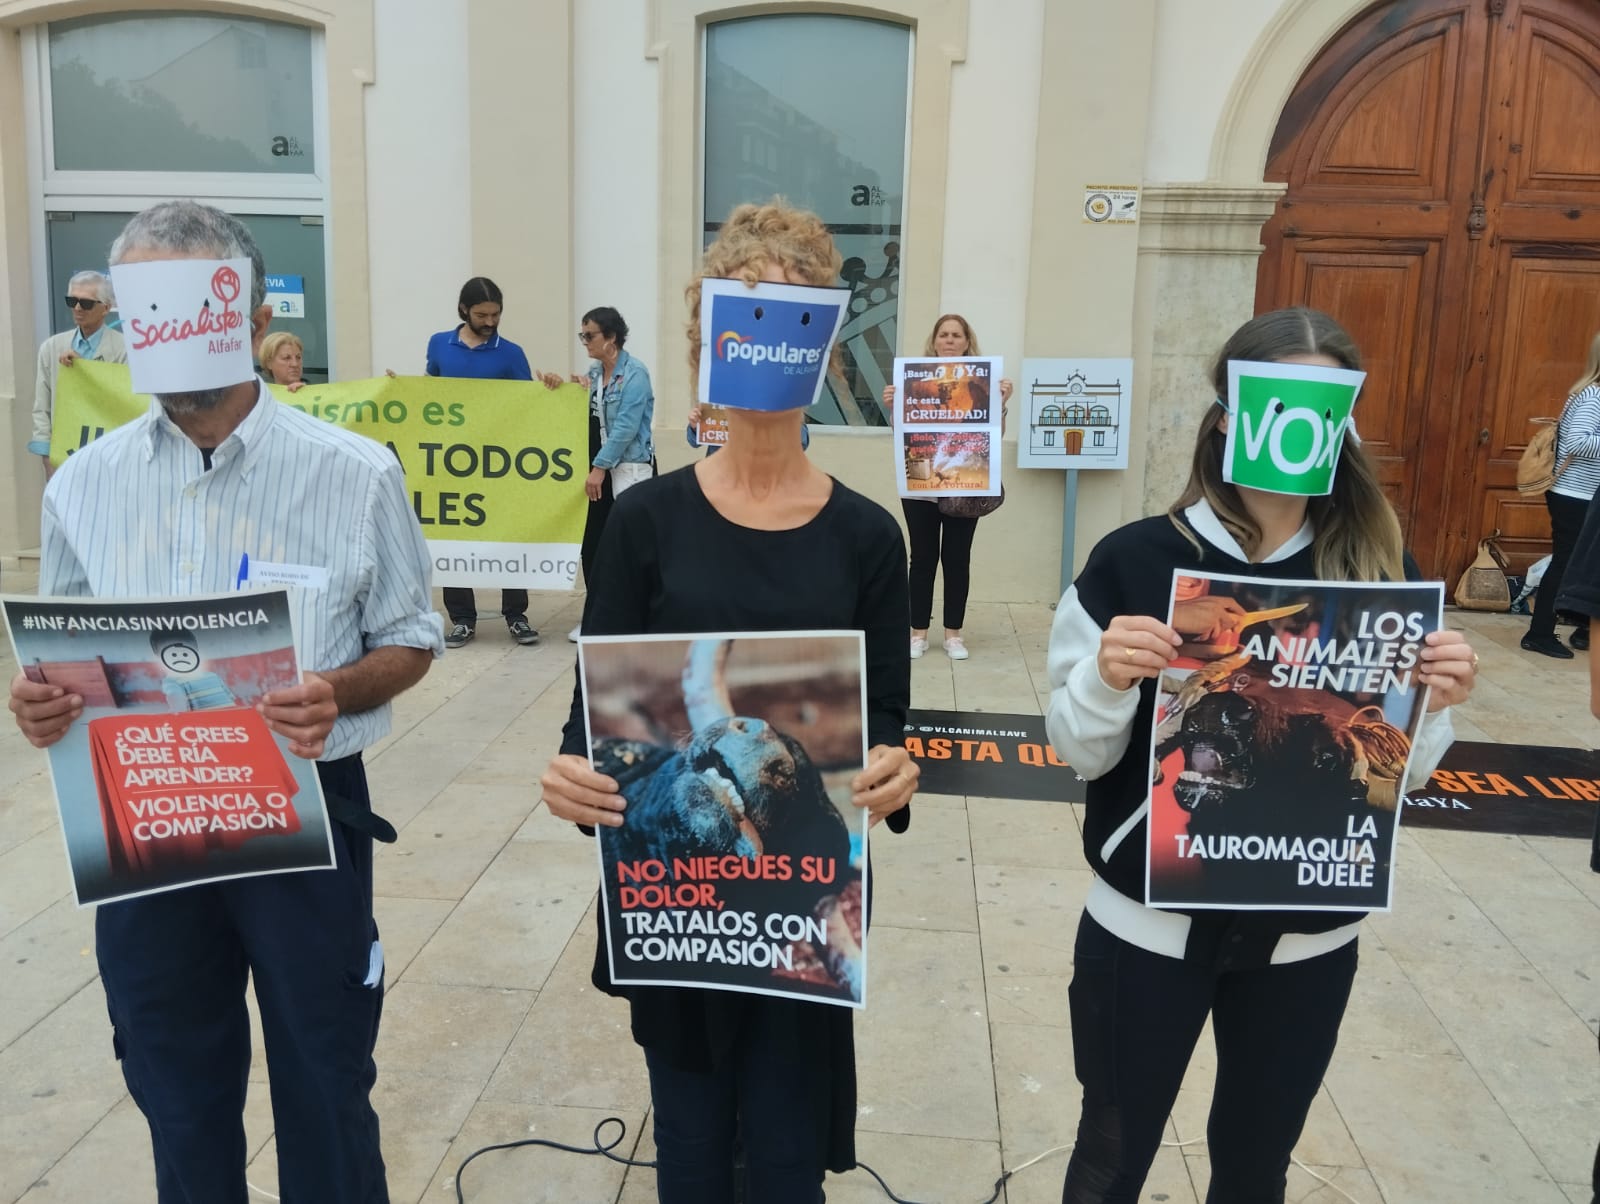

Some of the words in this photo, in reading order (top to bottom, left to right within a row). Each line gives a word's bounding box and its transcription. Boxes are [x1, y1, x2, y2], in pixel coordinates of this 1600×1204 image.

[208, 338, 242, 354] Alfafar
[727, 342, 821, 365] populares
[784, 366, 794, 375] DE
[423, 401, 465, 426] es
[906, 397, 918, 405] de
[920, 397, 941, 405] esta
[906, 409, 987, 422] ¡CRUELDAD!
[1242, 397, 1347, 475] VOX
[419, 442, 574, 482] TODOS
[912, 481, 926, 489] con
[945, 480, 983, 489] Tortura!
[435, 552, 578, 582] animal.org
[22, 608, 269, 631] #INFANCIASINVIOLENCIA
[1358, 611, 1424, 642] LOS
[1240, 634, 1419, 670] ANIMALES
[1268, 663, 1412, 696] SIENTEN
[115, 723, 177, 748] ¿QUÉ
[180, 726, 250, 744] CREES
[117, 746, 176, 766] DEBE
[179, 743, 219, 763] RÍA
[124, 766, 254, 788] APRENDER?
[1430, 769, 1529, 797] SEA
[127, 793, 261, 819] VIOLENCIA
[266, 792, 287, 809] O
[133, 809, 288, 841] COMPASIÓN
[1347, 815, 1378, 838] LA
[1174, 834, 1376, 862] TAUROMAQUIA
[617, 859, 666, 883] NO
[673, 855, 793, 881] NIEGUES
[800, 855, 836, 884] SU
[1298, 862, 1374, 887] DUELE
[619, 883, 726, 911] DOLOR,
[621, 911, 757, 937] TRATALOS
[764, 913, 828, 945] CON
[624, 935, 794, 971] COMPASIÓN
